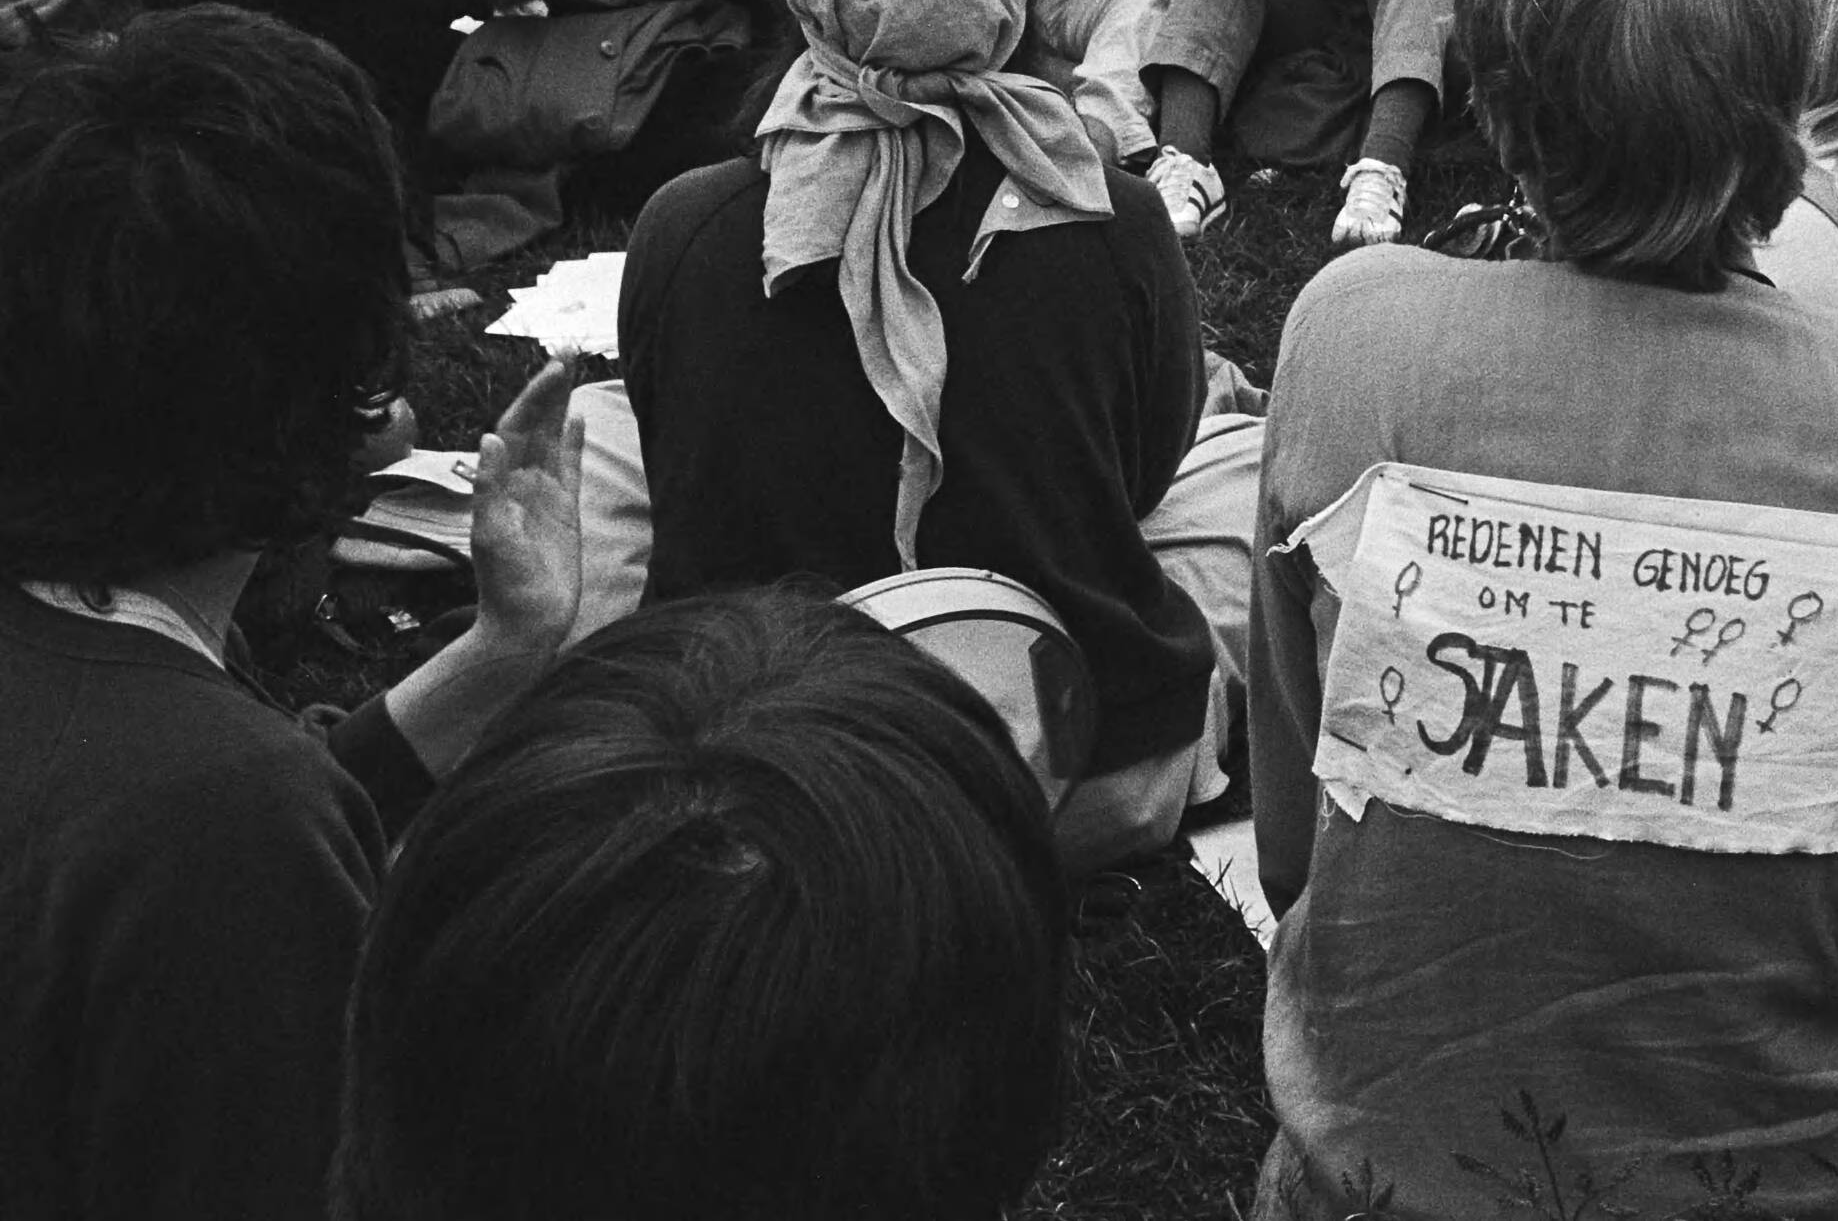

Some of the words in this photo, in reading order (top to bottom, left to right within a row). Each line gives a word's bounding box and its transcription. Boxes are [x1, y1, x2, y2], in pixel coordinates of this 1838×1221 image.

[1426, 514, 1602, 579] REDENEN
[1632, 549, 1770, 600] GENOEG
[1478, 586, 1531, 619] OM
[1549, 599, 1597, 629] TE
[1416, 632, 1748, 811] STAKEN
